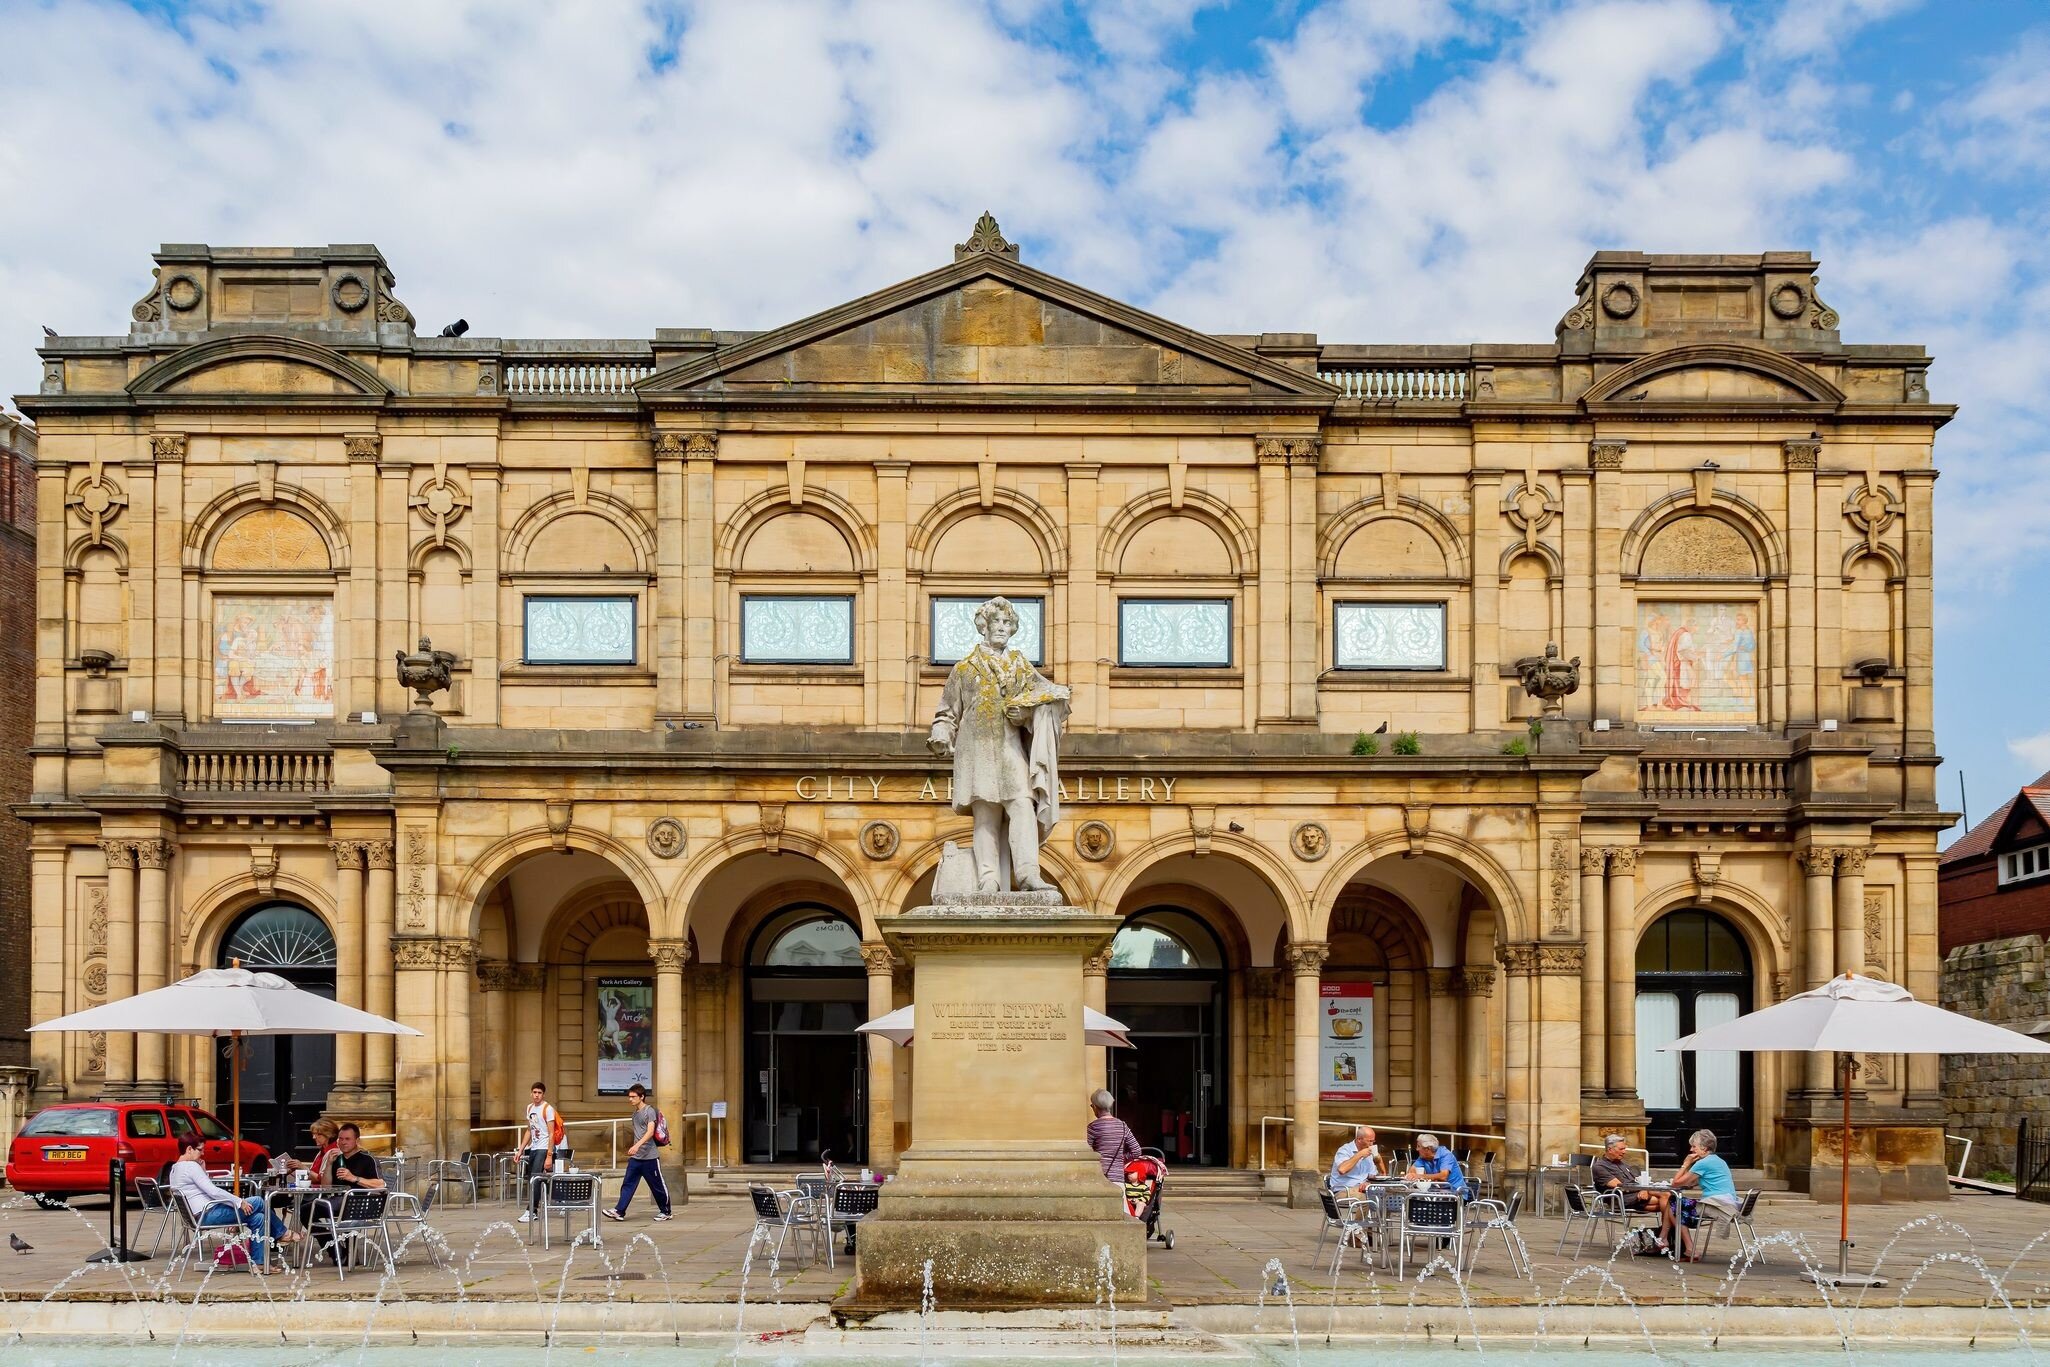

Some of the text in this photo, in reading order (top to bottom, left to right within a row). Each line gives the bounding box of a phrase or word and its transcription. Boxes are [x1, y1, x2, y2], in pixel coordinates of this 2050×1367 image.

[796, 776, 1177, 801] CITY ALLERY
[931, 1002, 996, 1018] WILLIAM
[621, 1013, 633, 1021] Art
[67, 1151, 82, 1159] BEG
